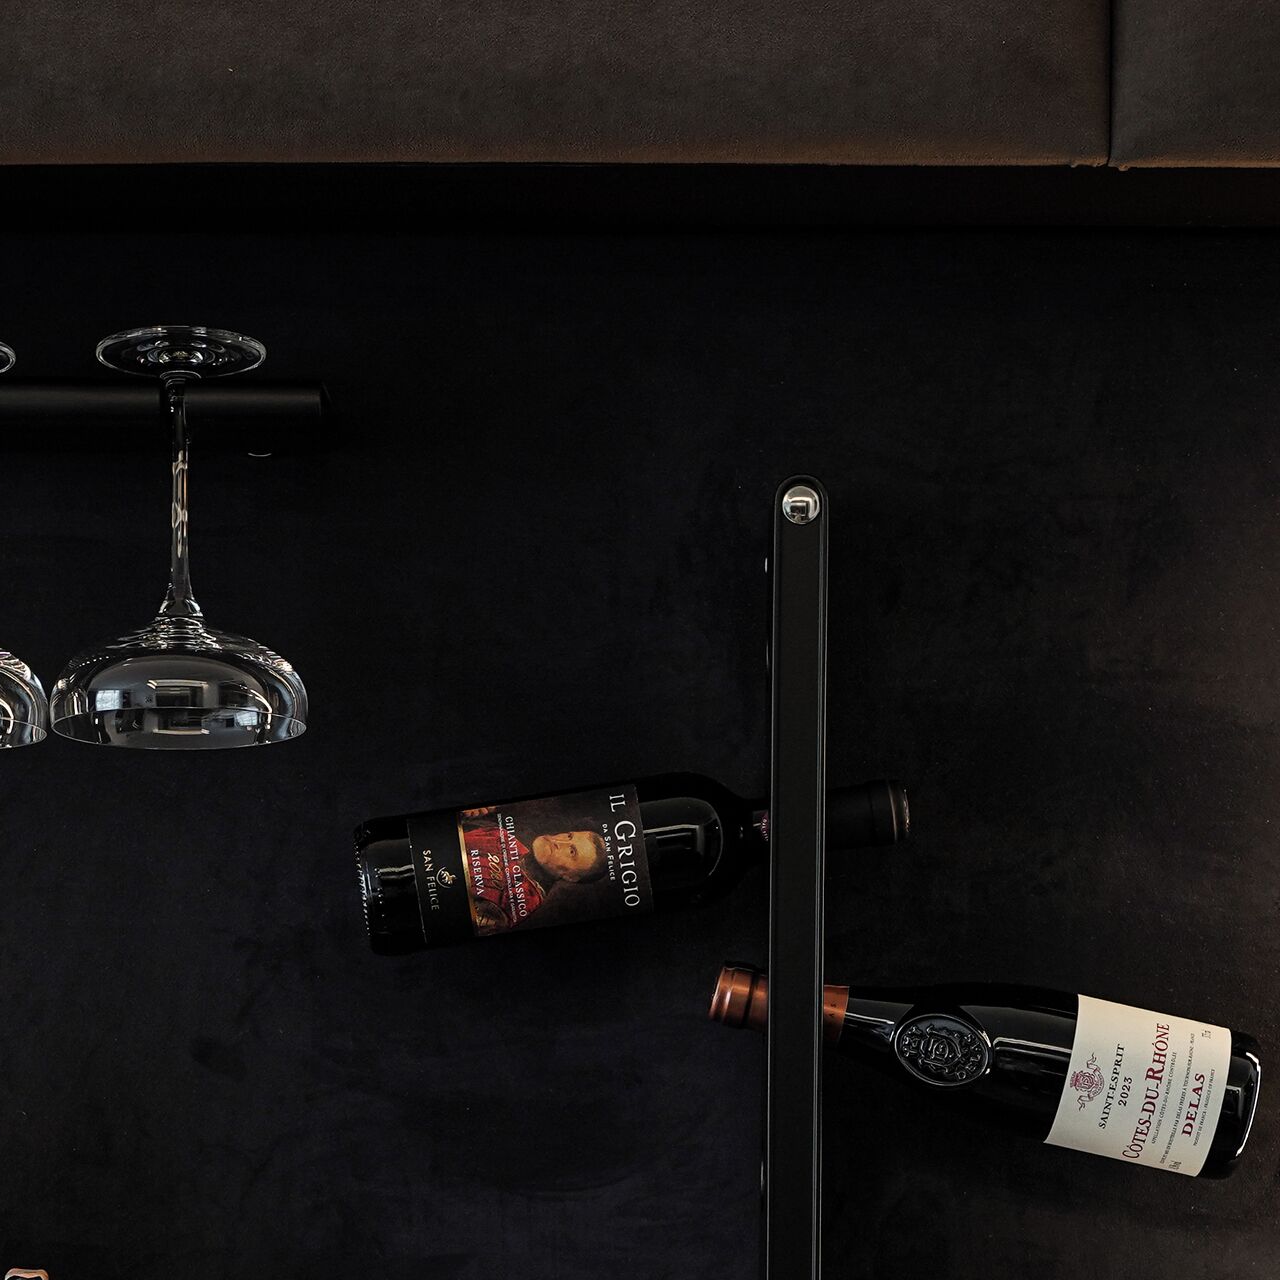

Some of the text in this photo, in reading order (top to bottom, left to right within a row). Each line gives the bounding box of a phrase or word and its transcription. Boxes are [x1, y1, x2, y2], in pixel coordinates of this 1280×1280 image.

[609, 794, 626, 813] IL
[422, 849, 439, 910] SAN FELICE
[470, 849, 484, 896] RISERVA
[504, 816, 528, 917] CHIANTI CLASSICO
[1098, 1043, 1125, 1129] SAINT-ESPRIT
[1118, 1076, 1132, 1107] 2023
[1182, 1073, 1205, 1137] DELAS
